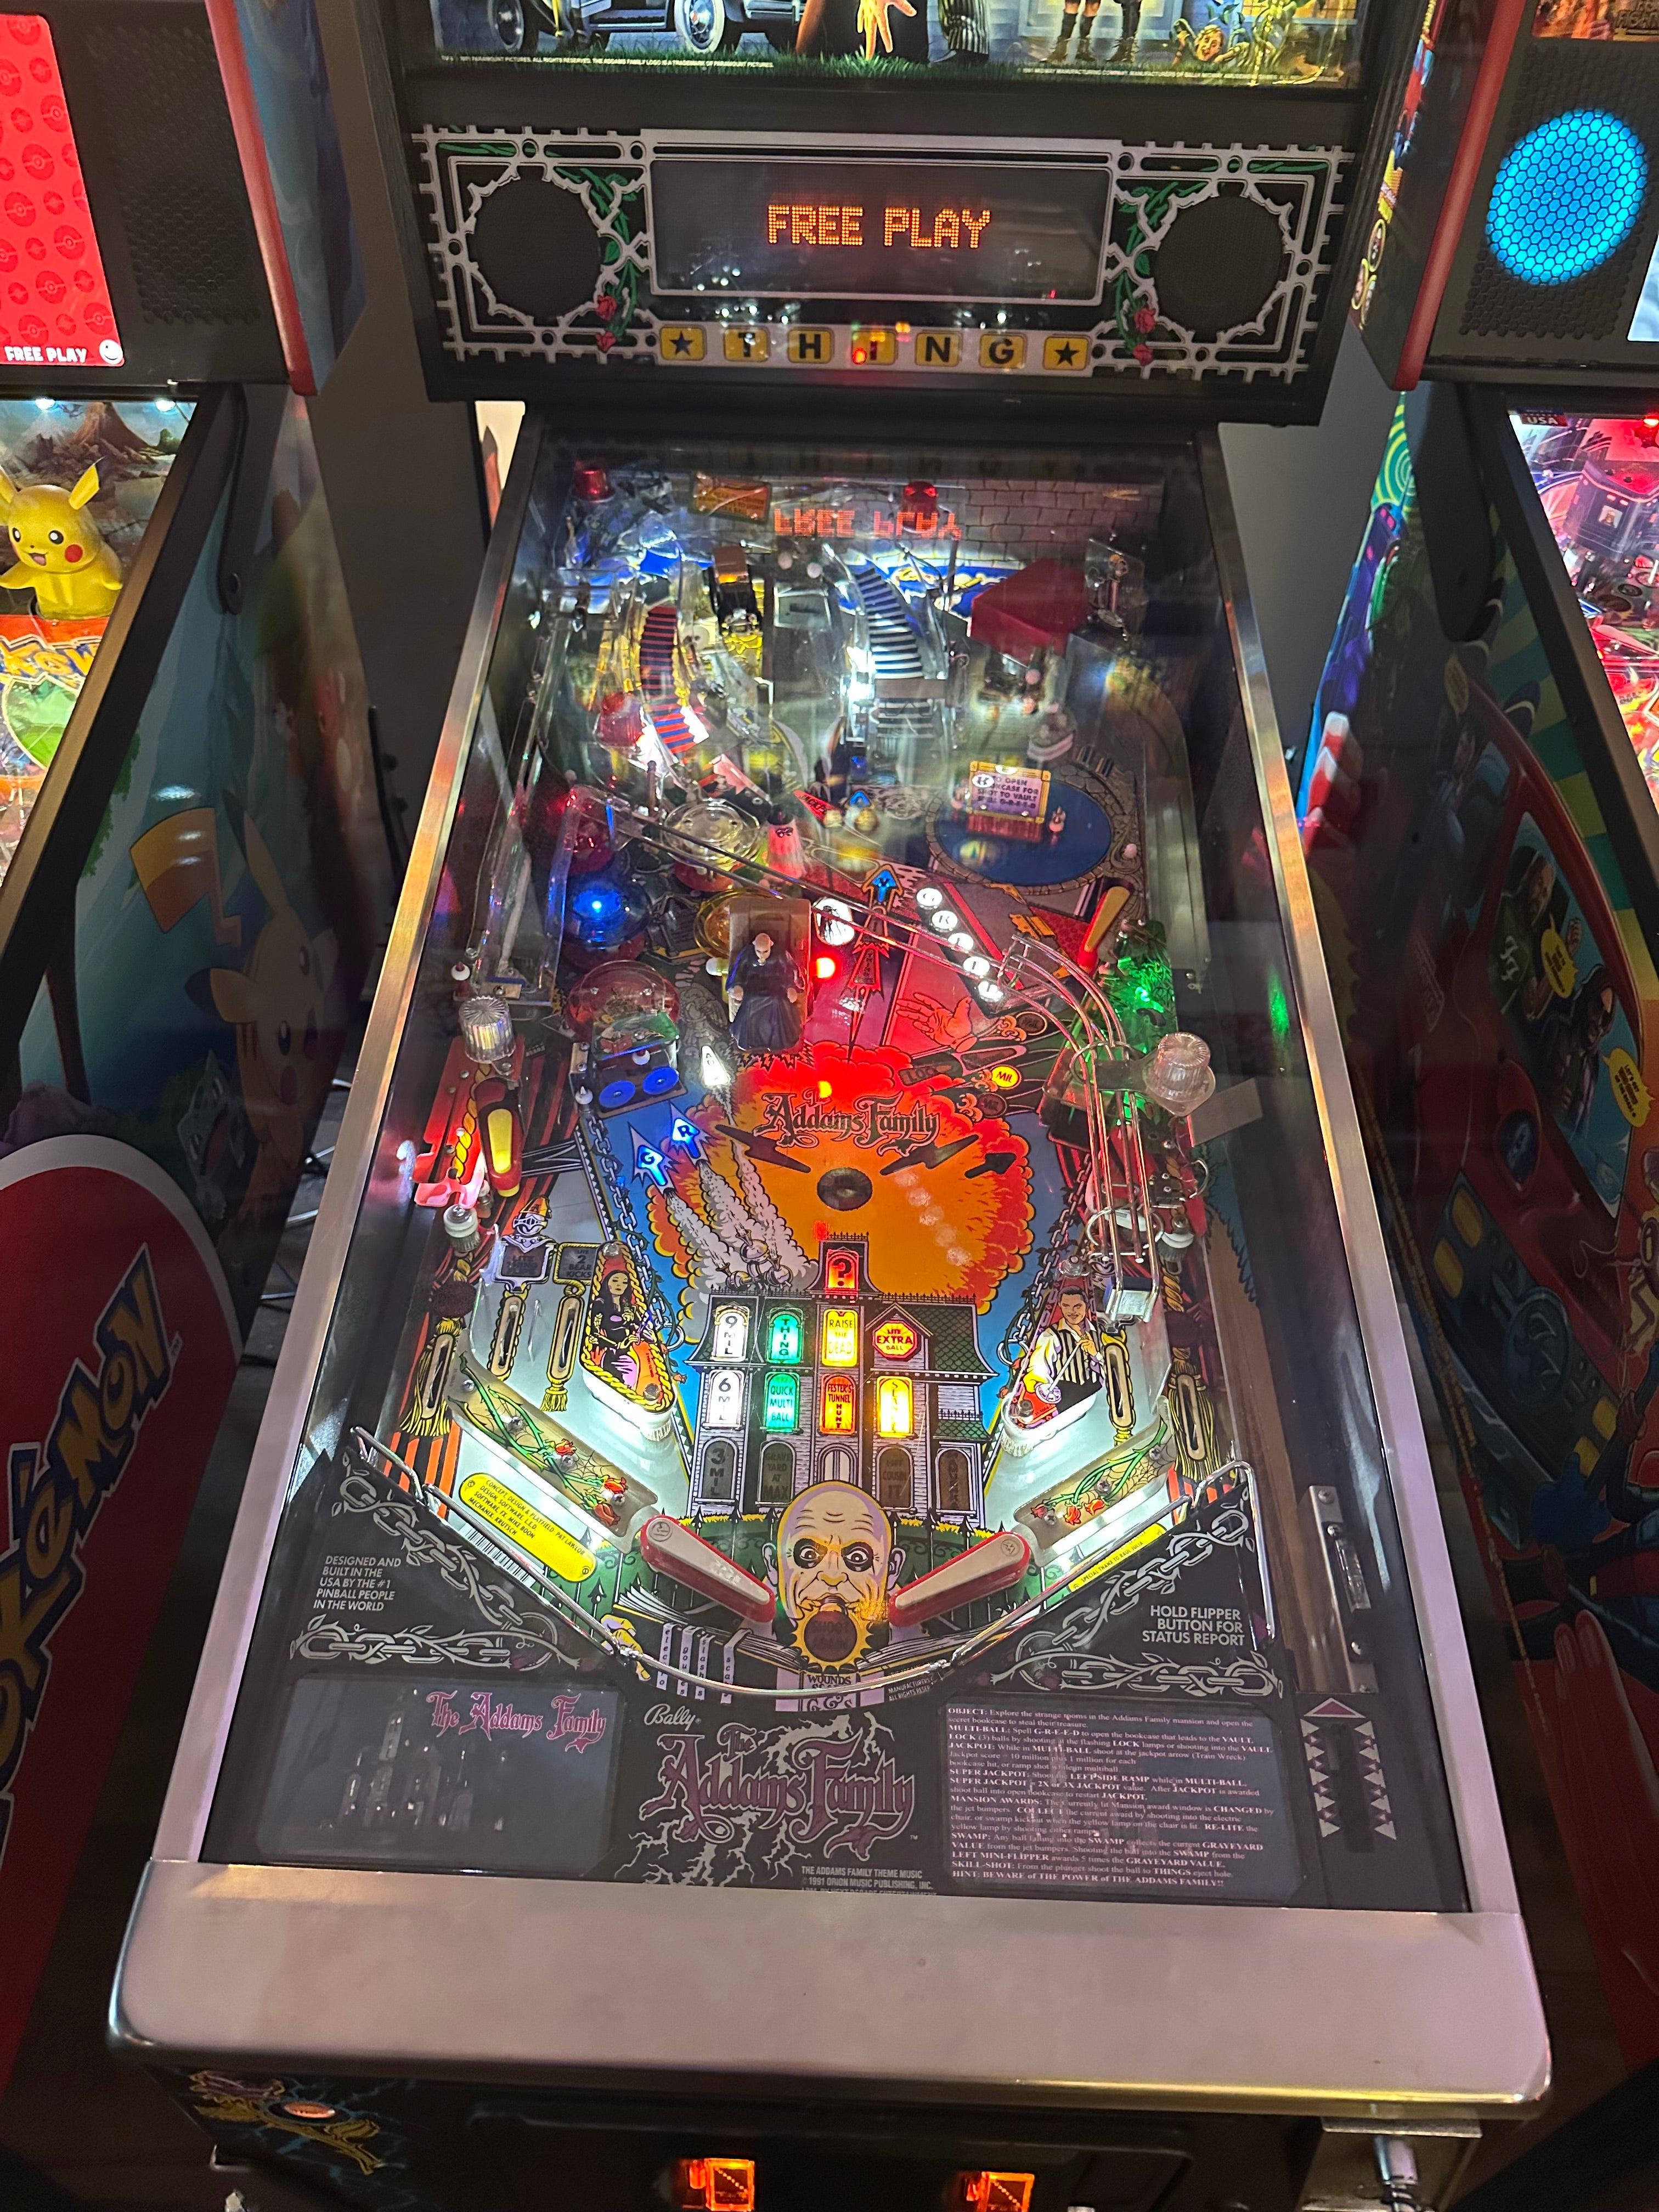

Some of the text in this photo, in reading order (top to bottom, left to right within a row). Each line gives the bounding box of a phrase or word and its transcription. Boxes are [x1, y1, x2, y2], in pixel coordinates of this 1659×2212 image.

[768, 205, 991, 249] FREE PLAY
[4, 346, 87, 363] FREE PLAY
[1526, 416, 1559, 425] USA
[1005, 777, 1028, 786] OPEN
[1013, 793, 1037, 802] VAULT
[996, 1070, 1013, 1083] MIL
[753, 1090, 940, 1156] Addams Family
[677, 1125, 691, 1138] R
[640, 1152, 655, 1165] G
[577, 1255, 586, 1264] 2
[725, 1315, 738, 1328] 9
[829, 1319, 853, 1328] RAISE
[780, 1318, 790, 1356] THING
[877, 1335, 913, 1345] EXTRA
[828, 1341, 852, 1355] DEAD
[718, 1378, 731, 1392] 6
[770, 1385, 794, 1396] QUICK
[827, 1383, 852, 1393] FESTER'S
[770, 1398, 793, 1408] MULTI
[828, 1393, 851, 1403] TUNNEL
[771, 1412, 789, 1422] BALL
[711, 1448, 726, 1465] 3
[767, 1463, 787, 1471] YARD
[709, 1468, 725, 1497] MIL
[772, 1474, 781, 1482] AT
[763, 1486, 789, 1499] MAX
[494, 1515, 518, 1536] KRUTSCH
[507, 1496, 526, 1510] DESIGN
[555, 1531, 566, 1541] PAT
[565, 1538, 585, 1556] LAWLOR
[507, 1516, 522, 1528] MIKE
[520, 1526, 535, 1539] BOON
[325, 1555, 402, 1567] DESIGNED AND
[1080, 1570, 1098, 1583] SPECIAL
[1131, 1541, 1143, 1551] JULIA
[323, 1566, 383, 1578] BUILT IN THE
[319, 1577, 391, 1589] USA BY THE #1
[316, 1588, 396, 1600] PINBALL PEOPLE
[313, 1599, 384, 1611] IN THE WORLD
[1150, 1605, 1241, 1620] HOLD FLIPPER
[1157, 1618, 1243, 1633] BUTTON FOR
[1142, 1630, 1245, 1646] STATUS REPORT
[697, 1639, 708, 1696] slashs
[808, 1674, 851, 1685] WOUNDS
[888, 1678, 930, 1694] MANUFACTURERS
[896, 1690, 915, 1700] RIGHTS
[426, 1690, 607, 1754] The Addams Family
[644, 1702, 696, 1731] Bally
[948, 1707, 988, 1716] OBJECT:
[990, 1709, 1019, 1719] Explore
[1034, 1712, 1062, 1720] strange
[1144, 1716, 1170, 1724] Family
[717, 1722, 758, 1761] The
[639, 1726, 915, 1861] Addams Family
[802, 1866, 923, 1879] THE ADDAMS FAMILY THEME MUSIC
[809, 1877, 934, 1890] 1991 ORION MUSIC PUBLISHING, INC.
[1062, 1874, 1098, 1882] POWER
[1135, 1876, 1177, 1885] ADDAMS
